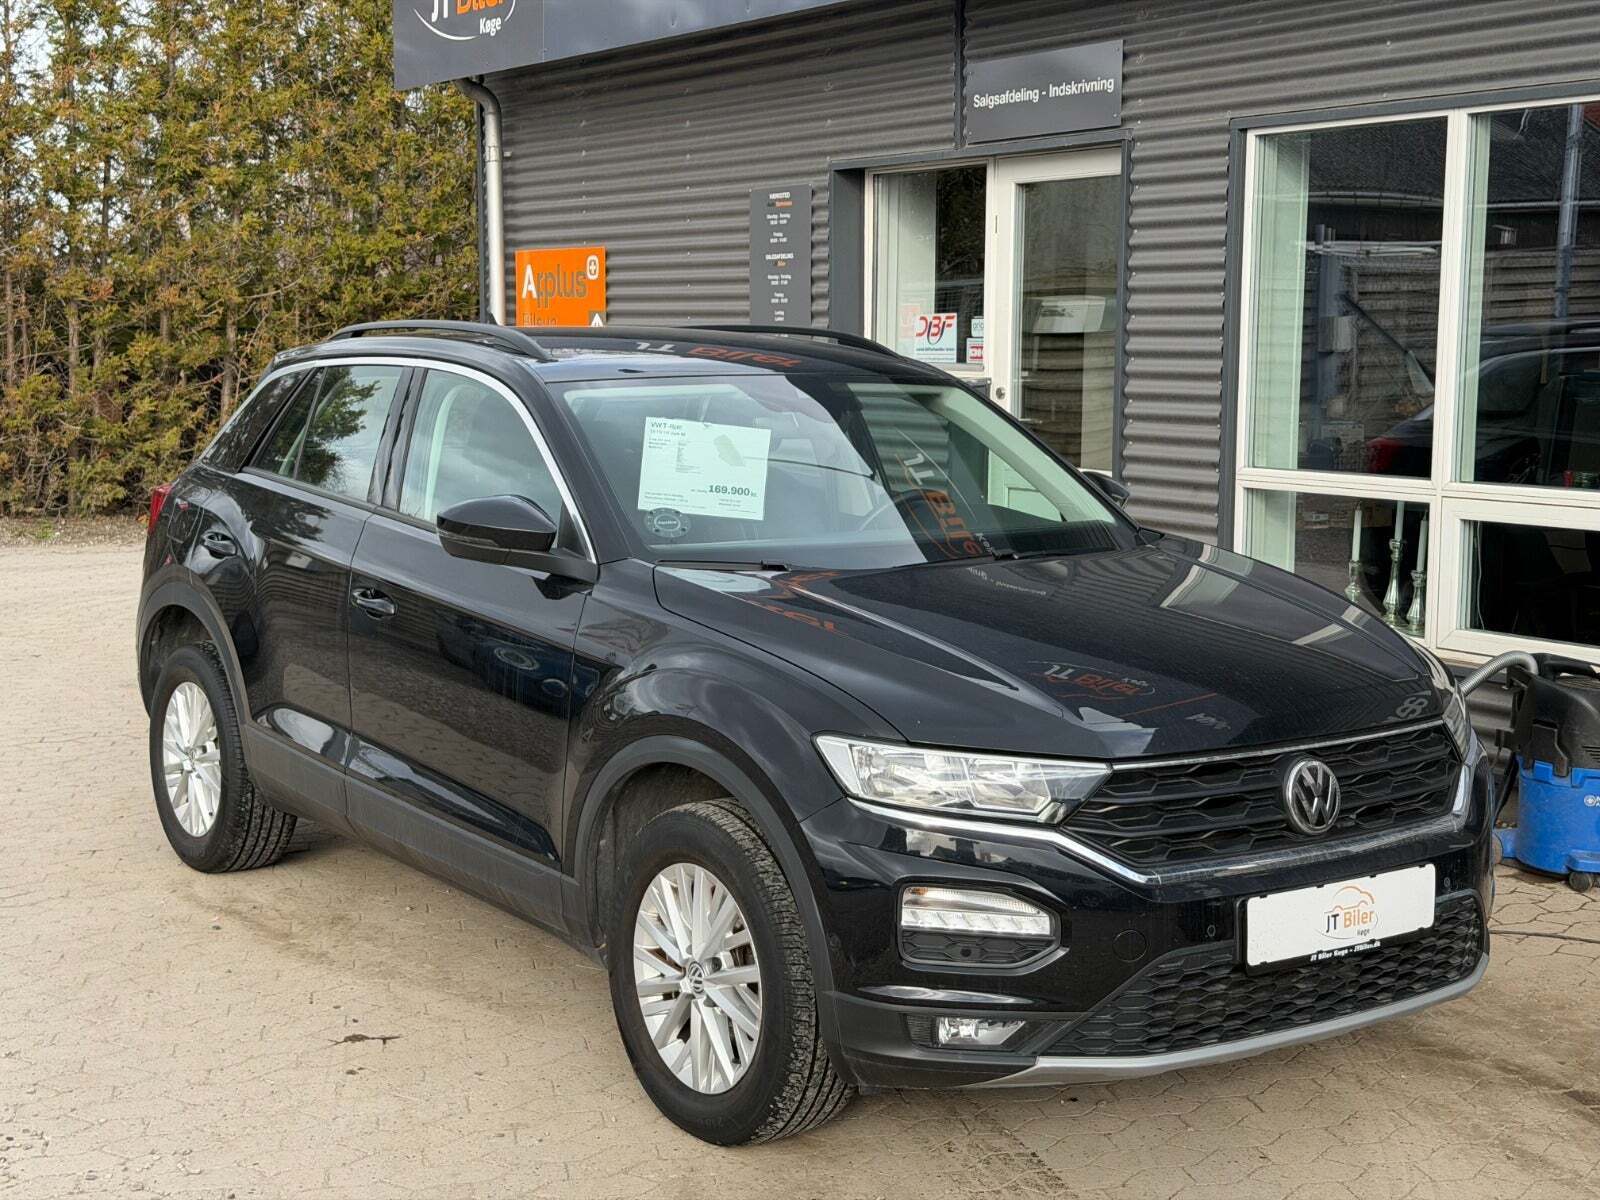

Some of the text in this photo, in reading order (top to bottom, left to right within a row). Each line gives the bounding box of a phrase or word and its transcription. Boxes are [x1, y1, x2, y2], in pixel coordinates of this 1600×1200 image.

[479, 17, 501, 36] Køge
[973, 88, 1039, 108] Salgsafdeling
[1049, 78, 1115, 97] Indskrivning
[708, 485, 750, 497] 169.900
[1326, 910, 1374, 933] JT Biler
